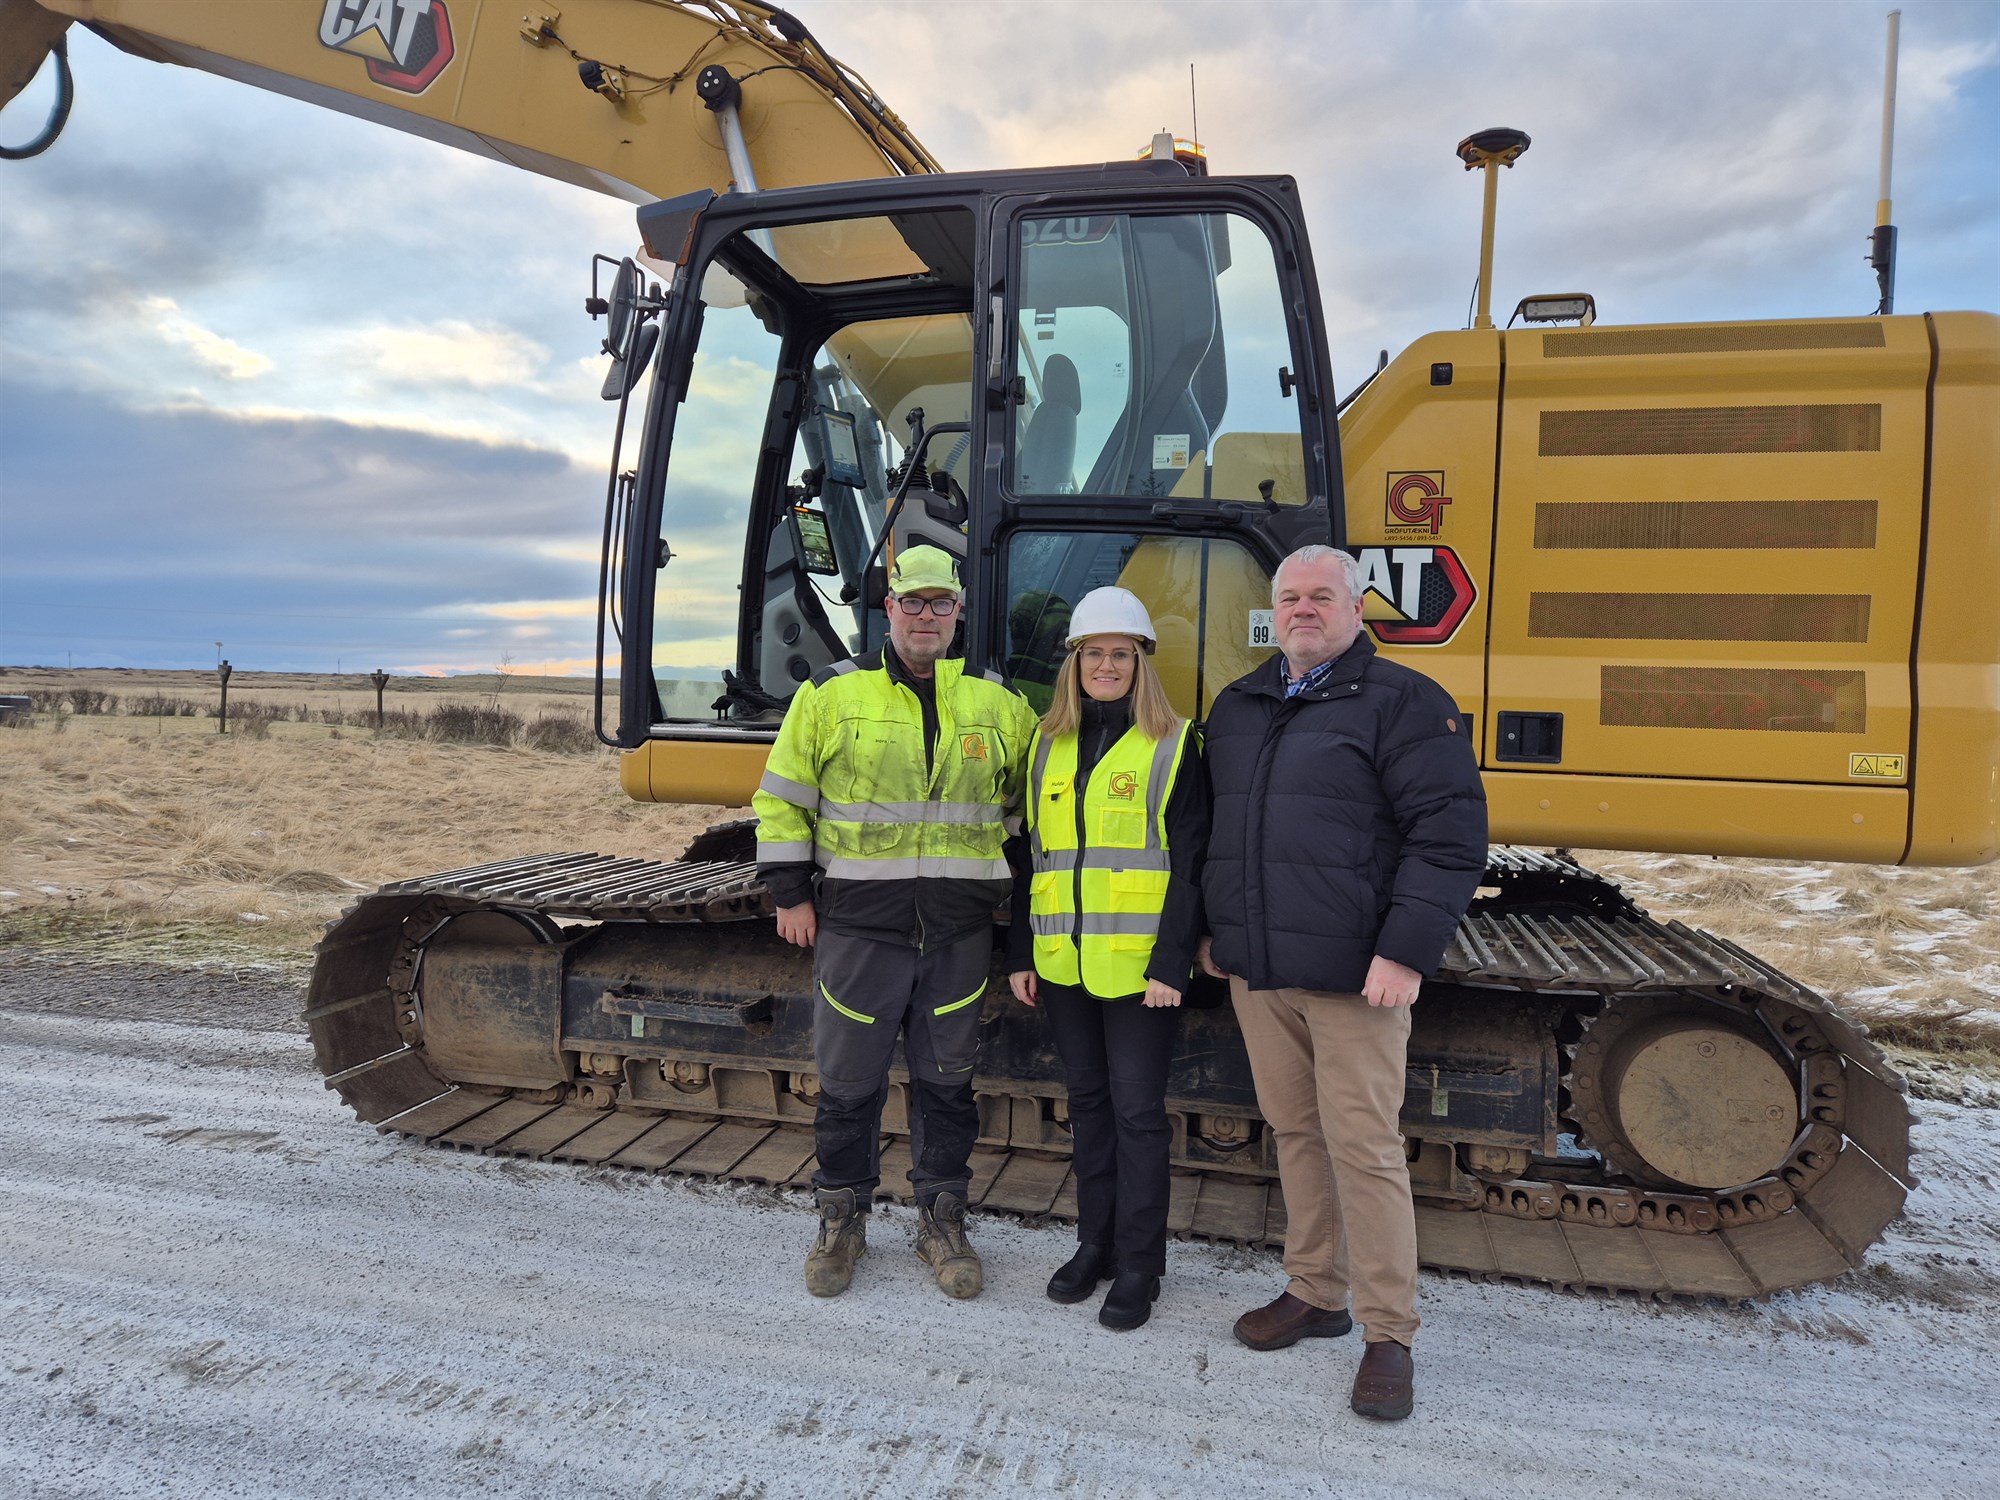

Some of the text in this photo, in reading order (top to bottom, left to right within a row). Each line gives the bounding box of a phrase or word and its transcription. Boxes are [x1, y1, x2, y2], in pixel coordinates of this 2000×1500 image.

[320, 0, 430, 66] CAT
[1359, 548, 1433, 620] AT
[1253, 625, 1269, 644] 99
